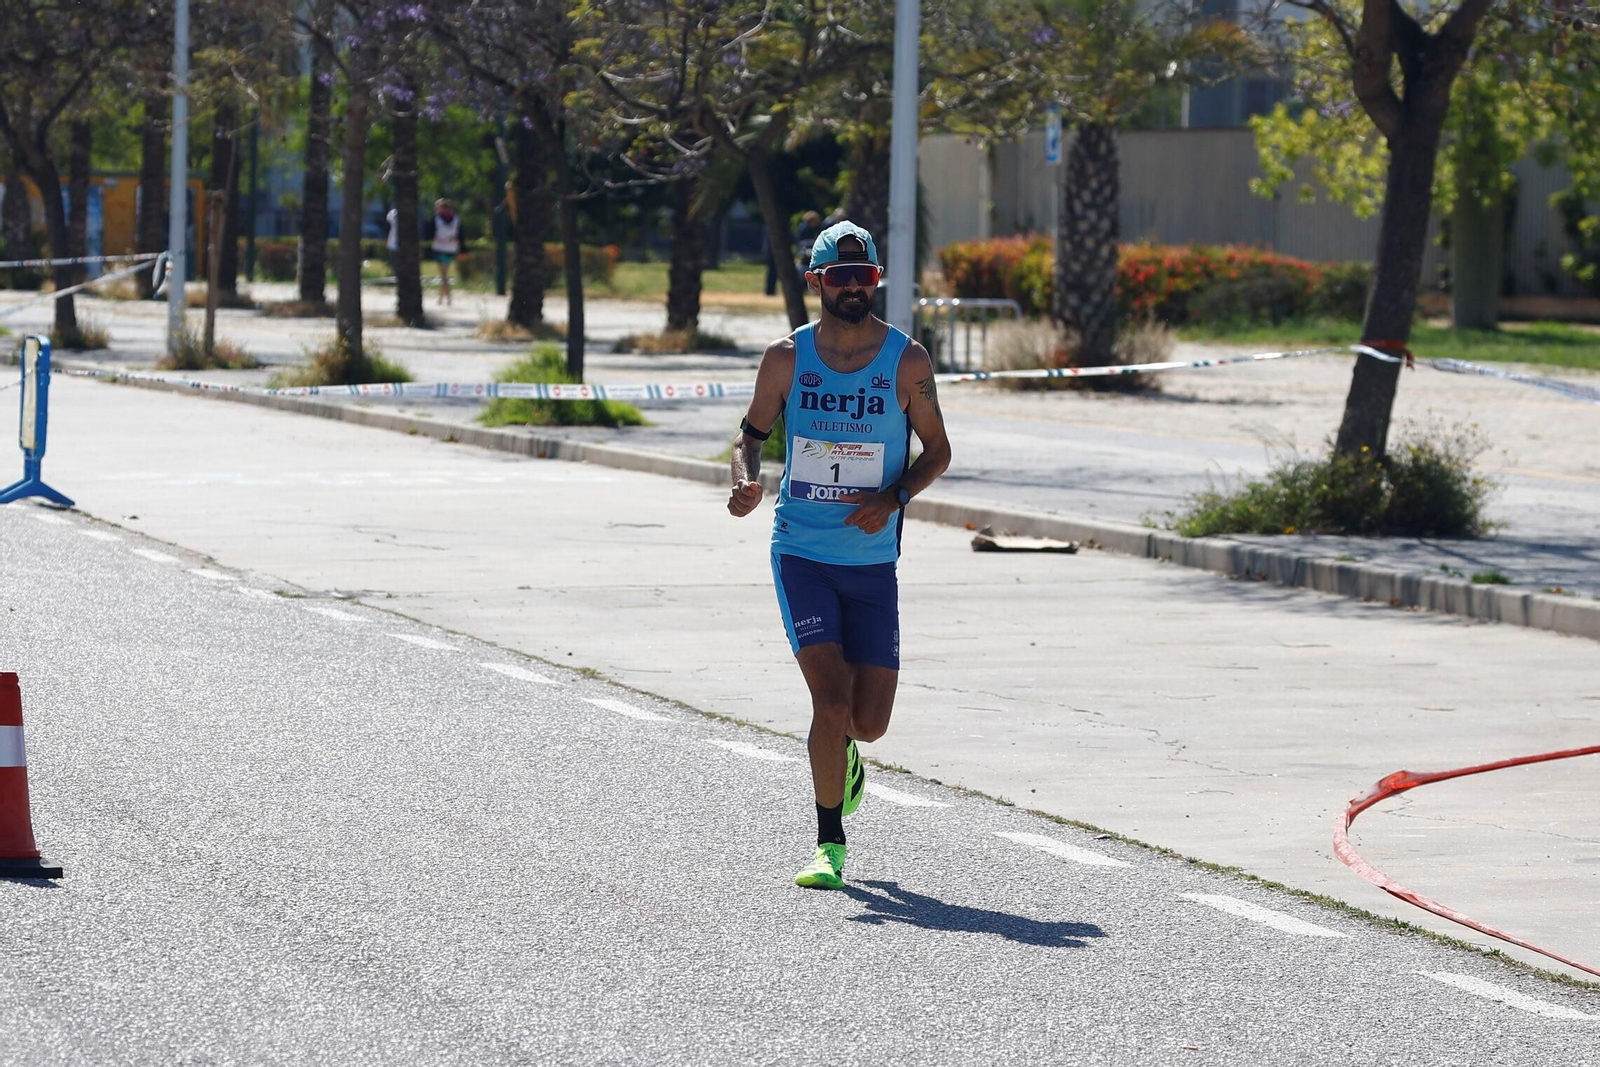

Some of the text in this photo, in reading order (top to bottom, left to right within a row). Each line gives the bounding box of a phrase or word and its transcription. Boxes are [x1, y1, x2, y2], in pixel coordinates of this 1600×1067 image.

[800, 375, 822, 385] TROPS
[799, 387, 885, 419] nerja
[810, 420, 873, 434] ATLETISMO
[829, 463, 840, 483] 1
[794, 615, 823, 628] nerja
